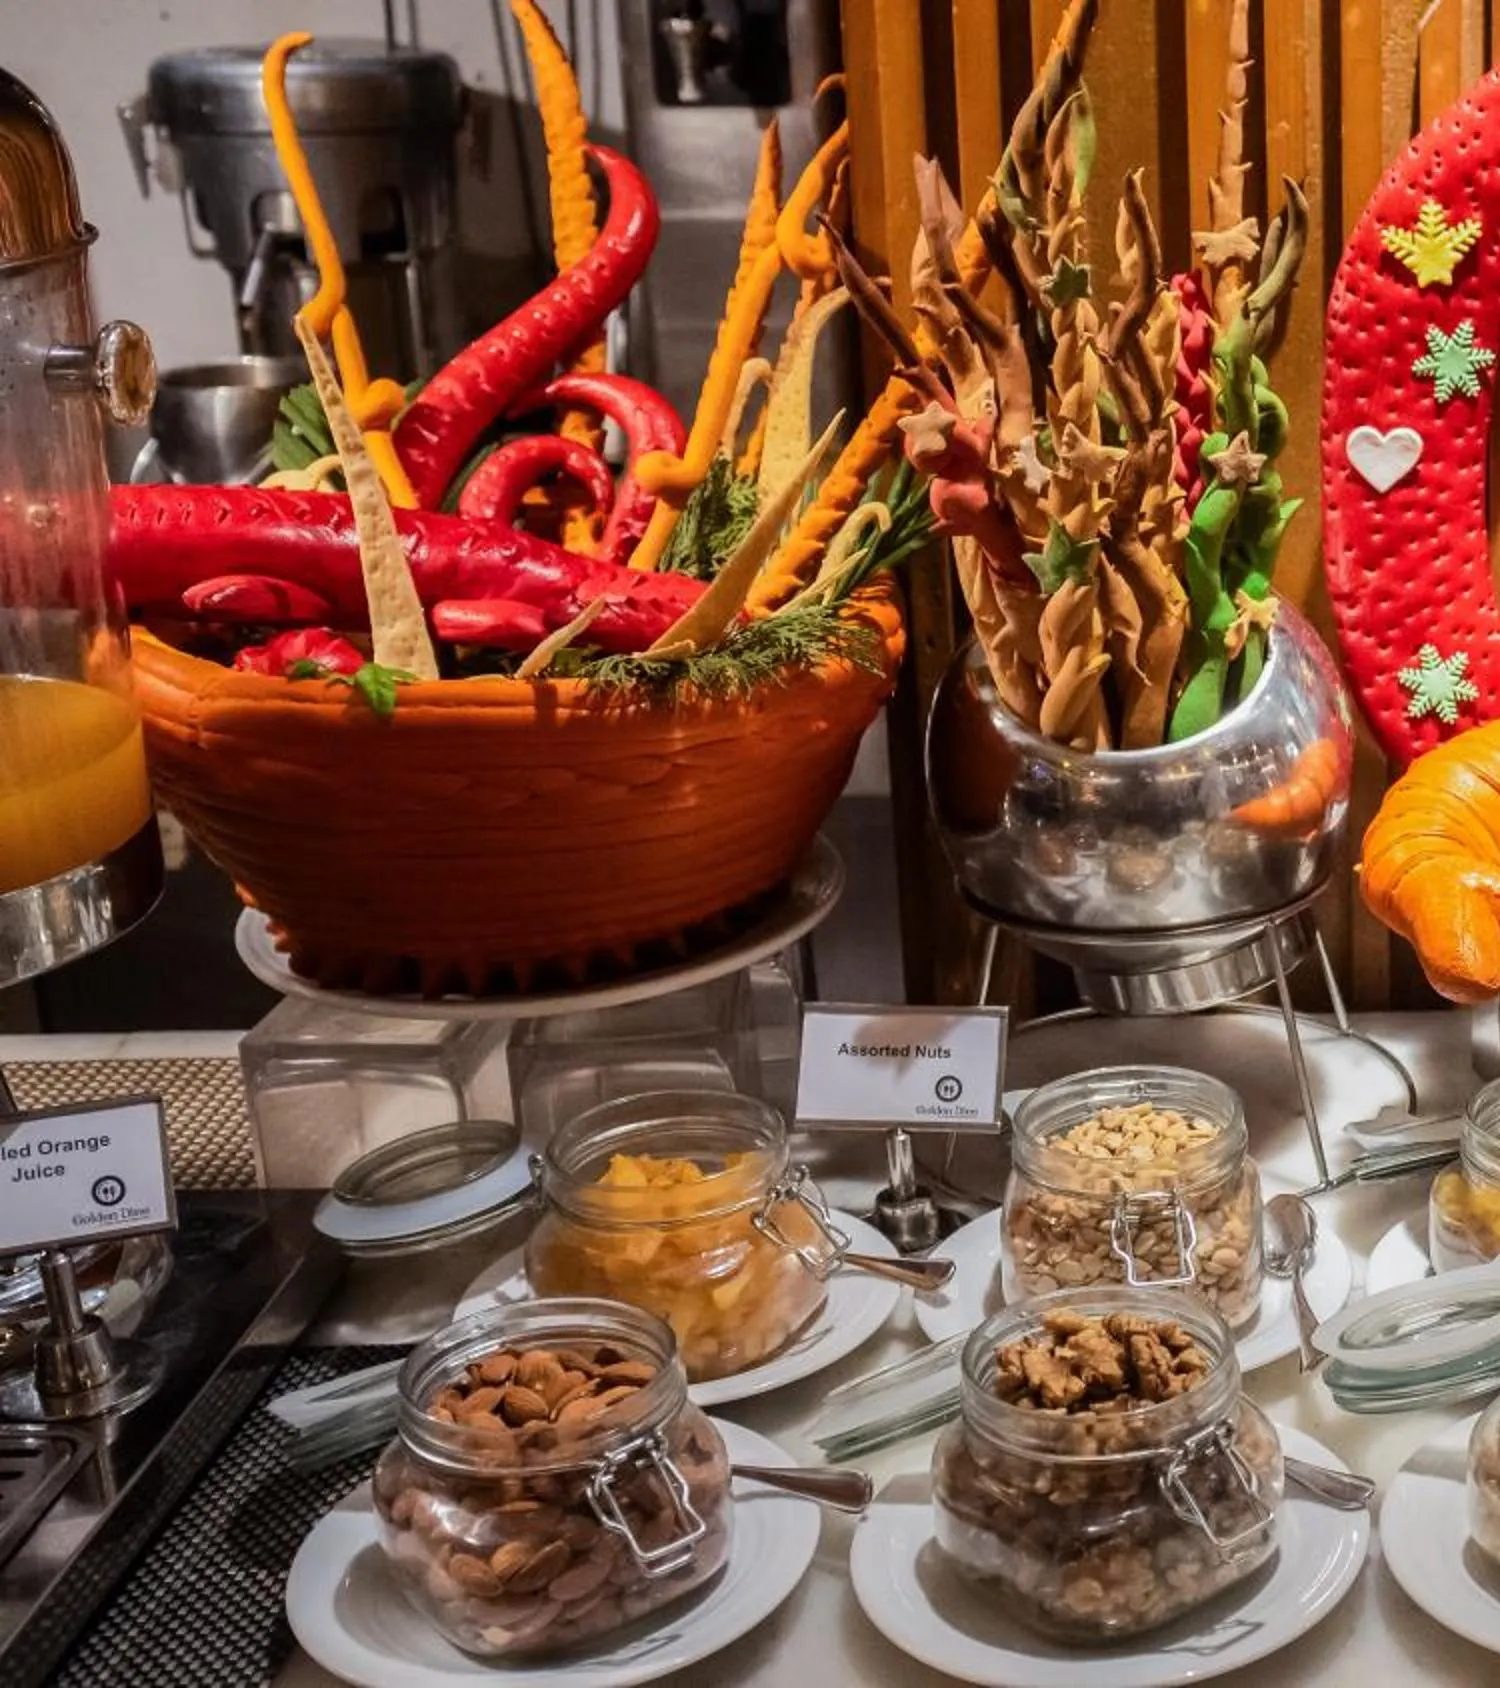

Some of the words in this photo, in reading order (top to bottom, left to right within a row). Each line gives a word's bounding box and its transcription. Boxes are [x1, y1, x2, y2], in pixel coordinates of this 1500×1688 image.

[838, 1043, 910, 1057] Assorted
[915, 1045, 951, 1059] Nuts
[38, 1135, 111, 1155] Orange
[12, 1163, 65, 1182] Juice
